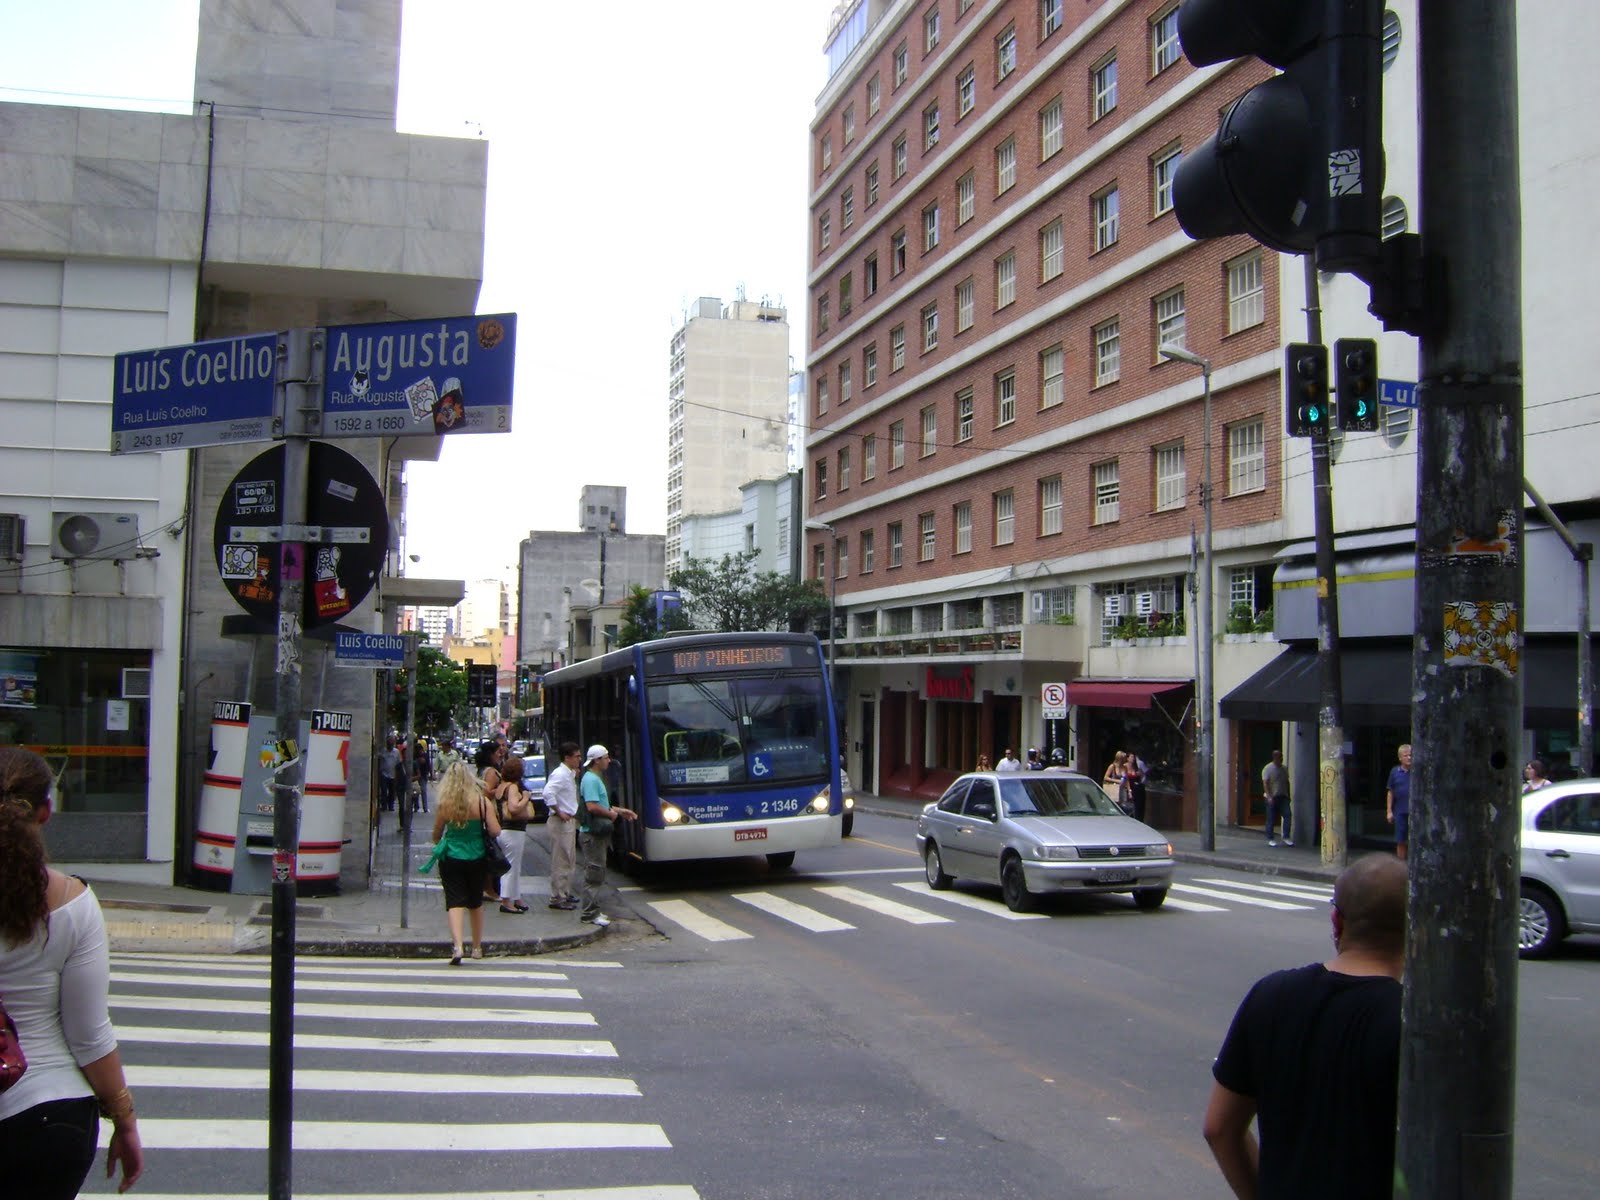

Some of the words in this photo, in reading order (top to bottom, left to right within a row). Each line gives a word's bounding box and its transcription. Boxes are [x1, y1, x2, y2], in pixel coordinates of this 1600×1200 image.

[333, 324, 469, 381] Augusta
[122, 350, 171, 394] Luís
[181, 339, 273, 387] Coelho
[331, 391, 354, 404] Rua
[358, 390, 406, 405] Augusta
[1380, 383, 1418, 405] Luí
[123, 412, 144, 425] Rua
[170, 405, 208, 420] Coelho
[498, 415, 506, 428] 2
[334, 418, 361, 431] 1592
[364, 419, 372, 429] a
[377, 416, 405, 430] 1660
[1296, 426, 1324, 436] A-134
[1345, 420, 1372, 431] A-134
[115, 440, 122, 452] 2
[133, 434, 152, 448] 243
[155, 437, 162, 446] a
[165, 432, 184, 445] 197
[339, 633, 361, 648] Luís
[365, 635, 403, 650] Coelho
[673, 651, 701, 668] 107P
[705, 647, 784, 667] PINHEIROS
[707, 804, 729, 812] Baixo
[761, 801, 769, 813] 2
[772, 799, 798, 812] 1346
[695, 811, 724, 819] Central
